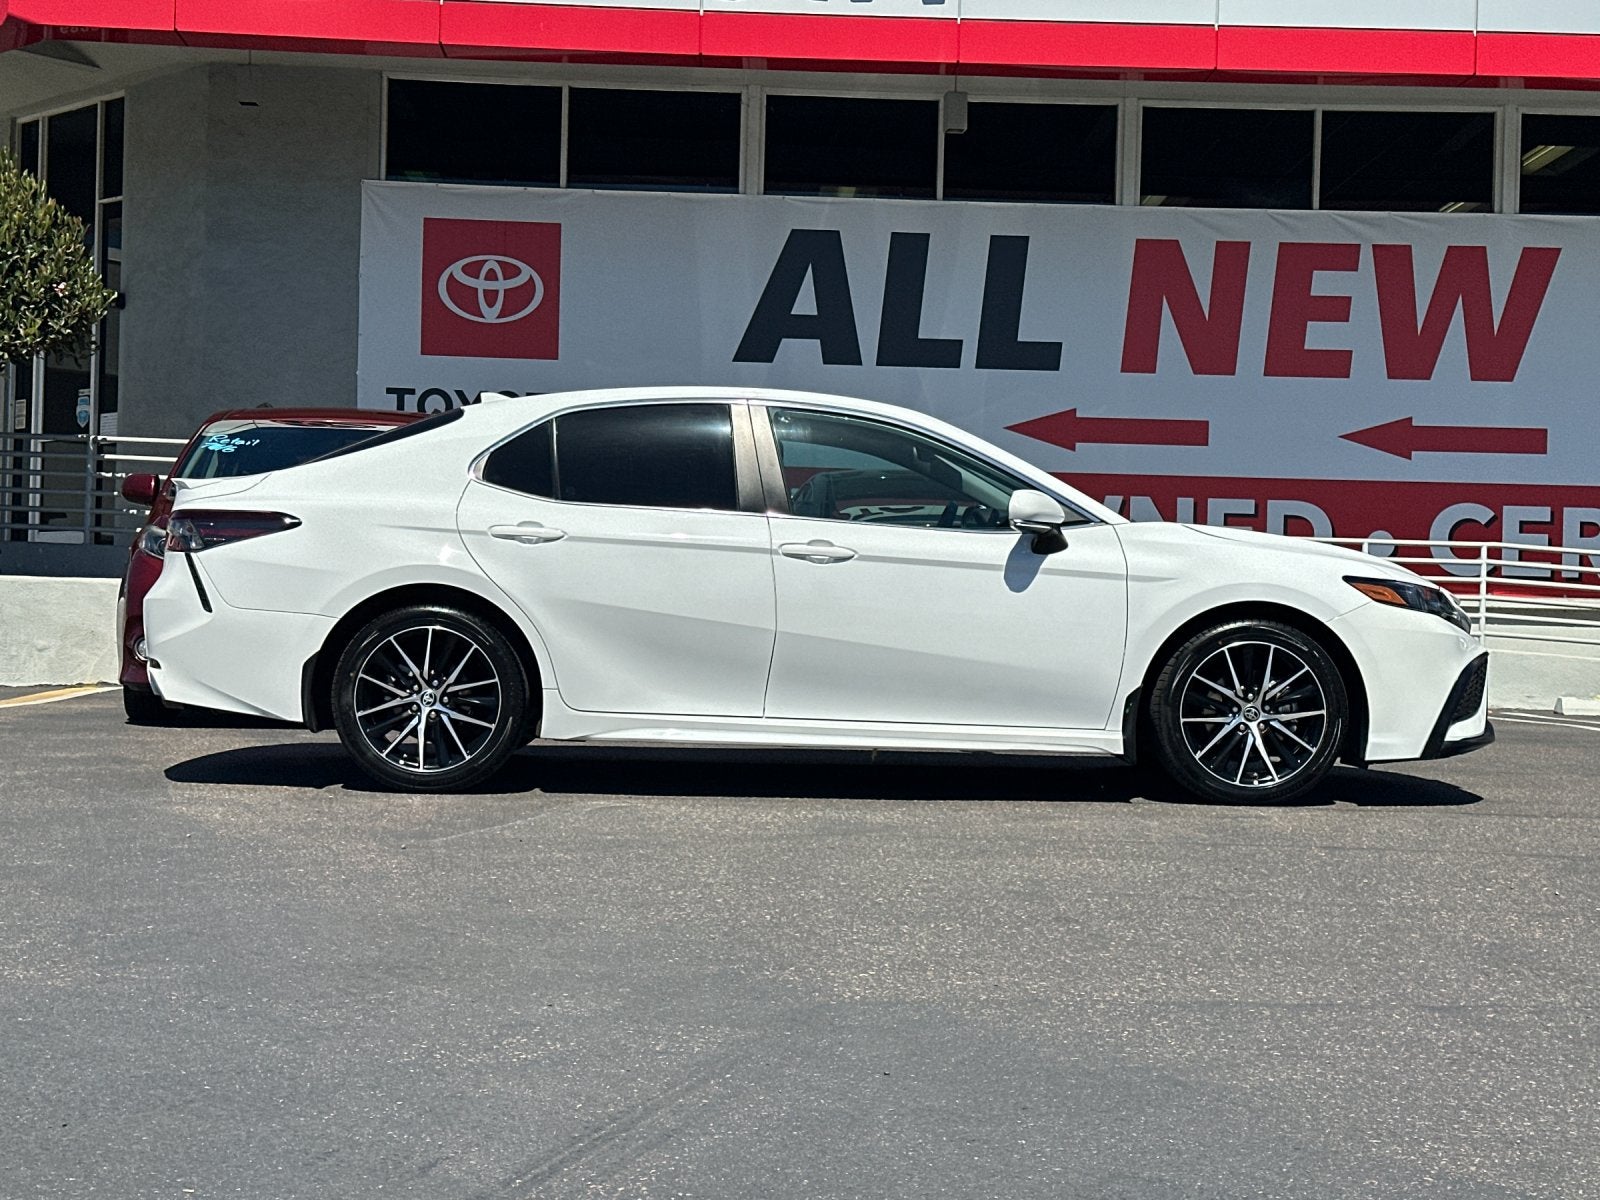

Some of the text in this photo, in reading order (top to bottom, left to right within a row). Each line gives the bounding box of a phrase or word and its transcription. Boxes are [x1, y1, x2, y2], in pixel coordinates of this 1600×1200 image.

[732, 228, 1562, 382] ALL NEW
[386, 387, 556, 414] TOY
